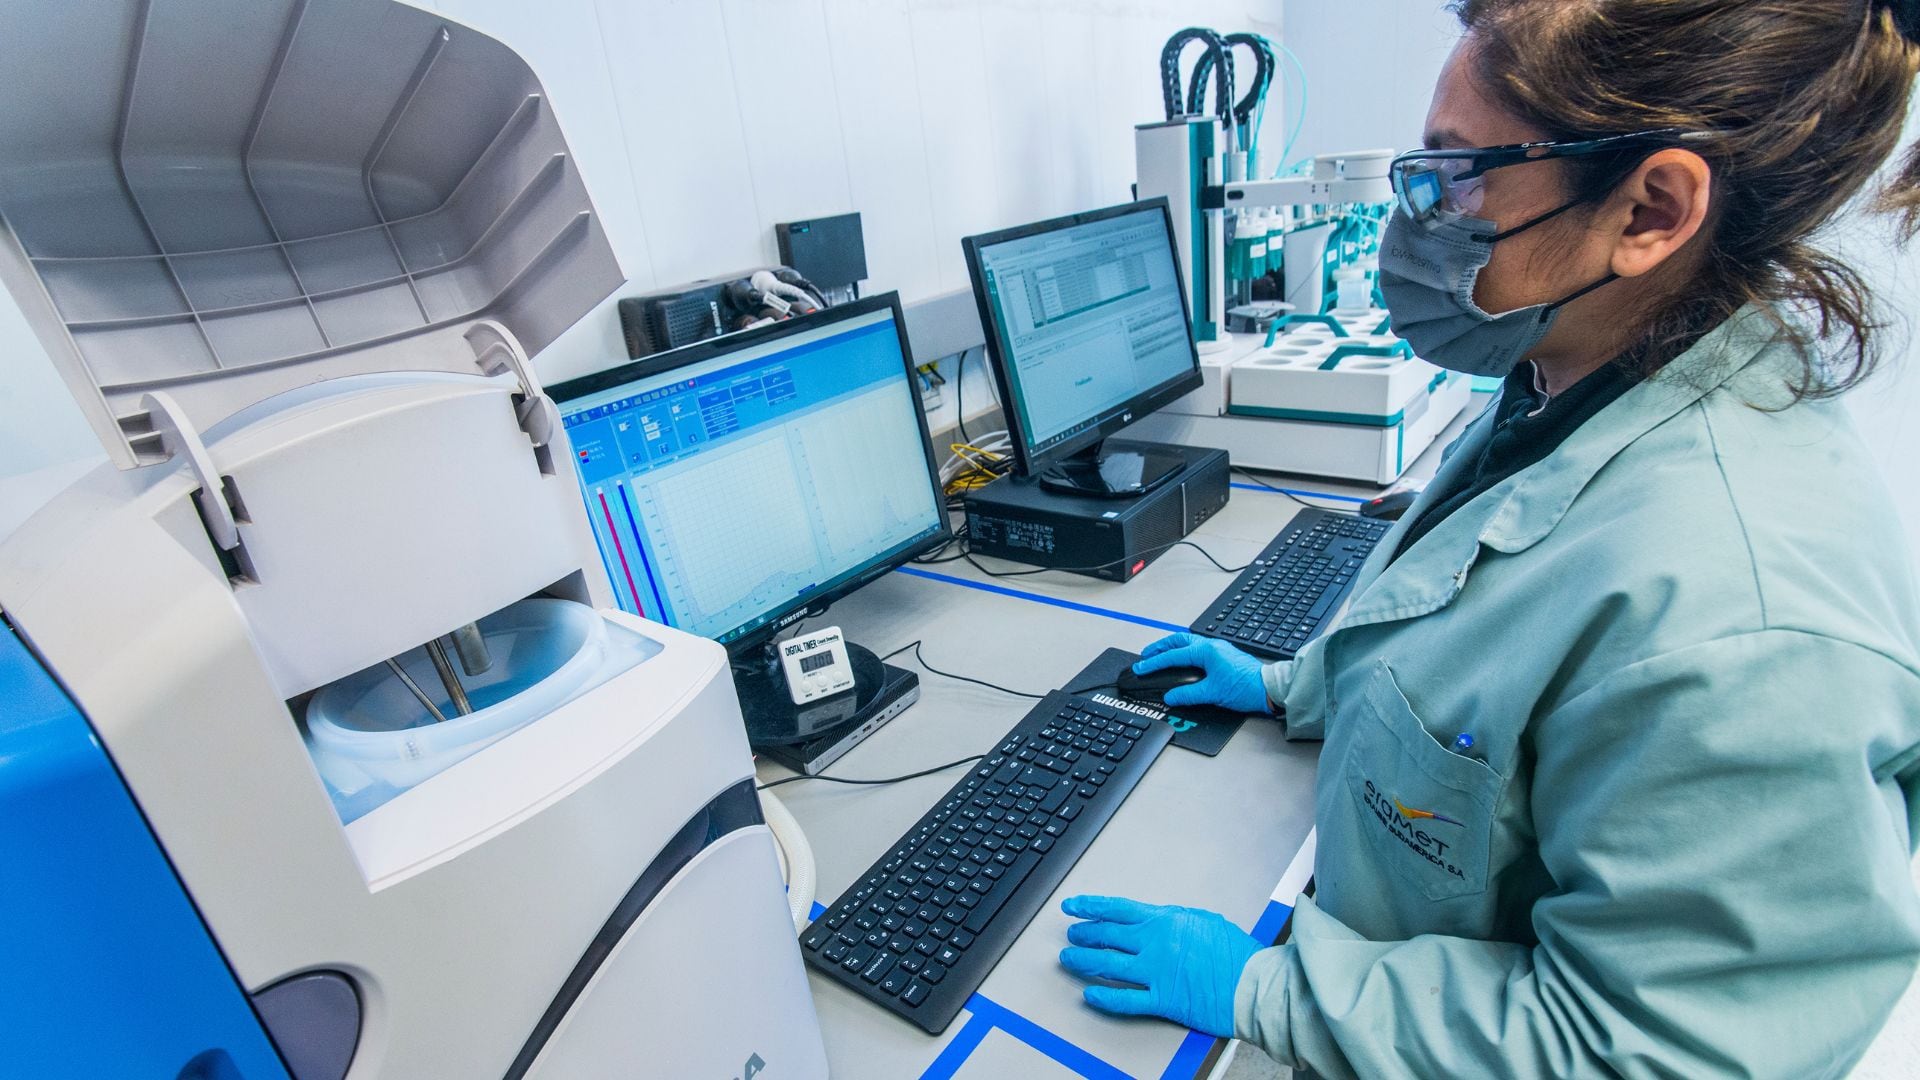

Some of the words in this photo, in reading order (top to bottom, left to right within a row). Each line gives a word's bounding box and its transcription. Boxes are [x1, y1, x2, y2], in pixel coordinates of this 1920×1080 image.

[780, 607, 808, 627] SAMSUNG
[785, 644, 803, 657] DIGITAL
[803, 639, 818, 651] TIMER
